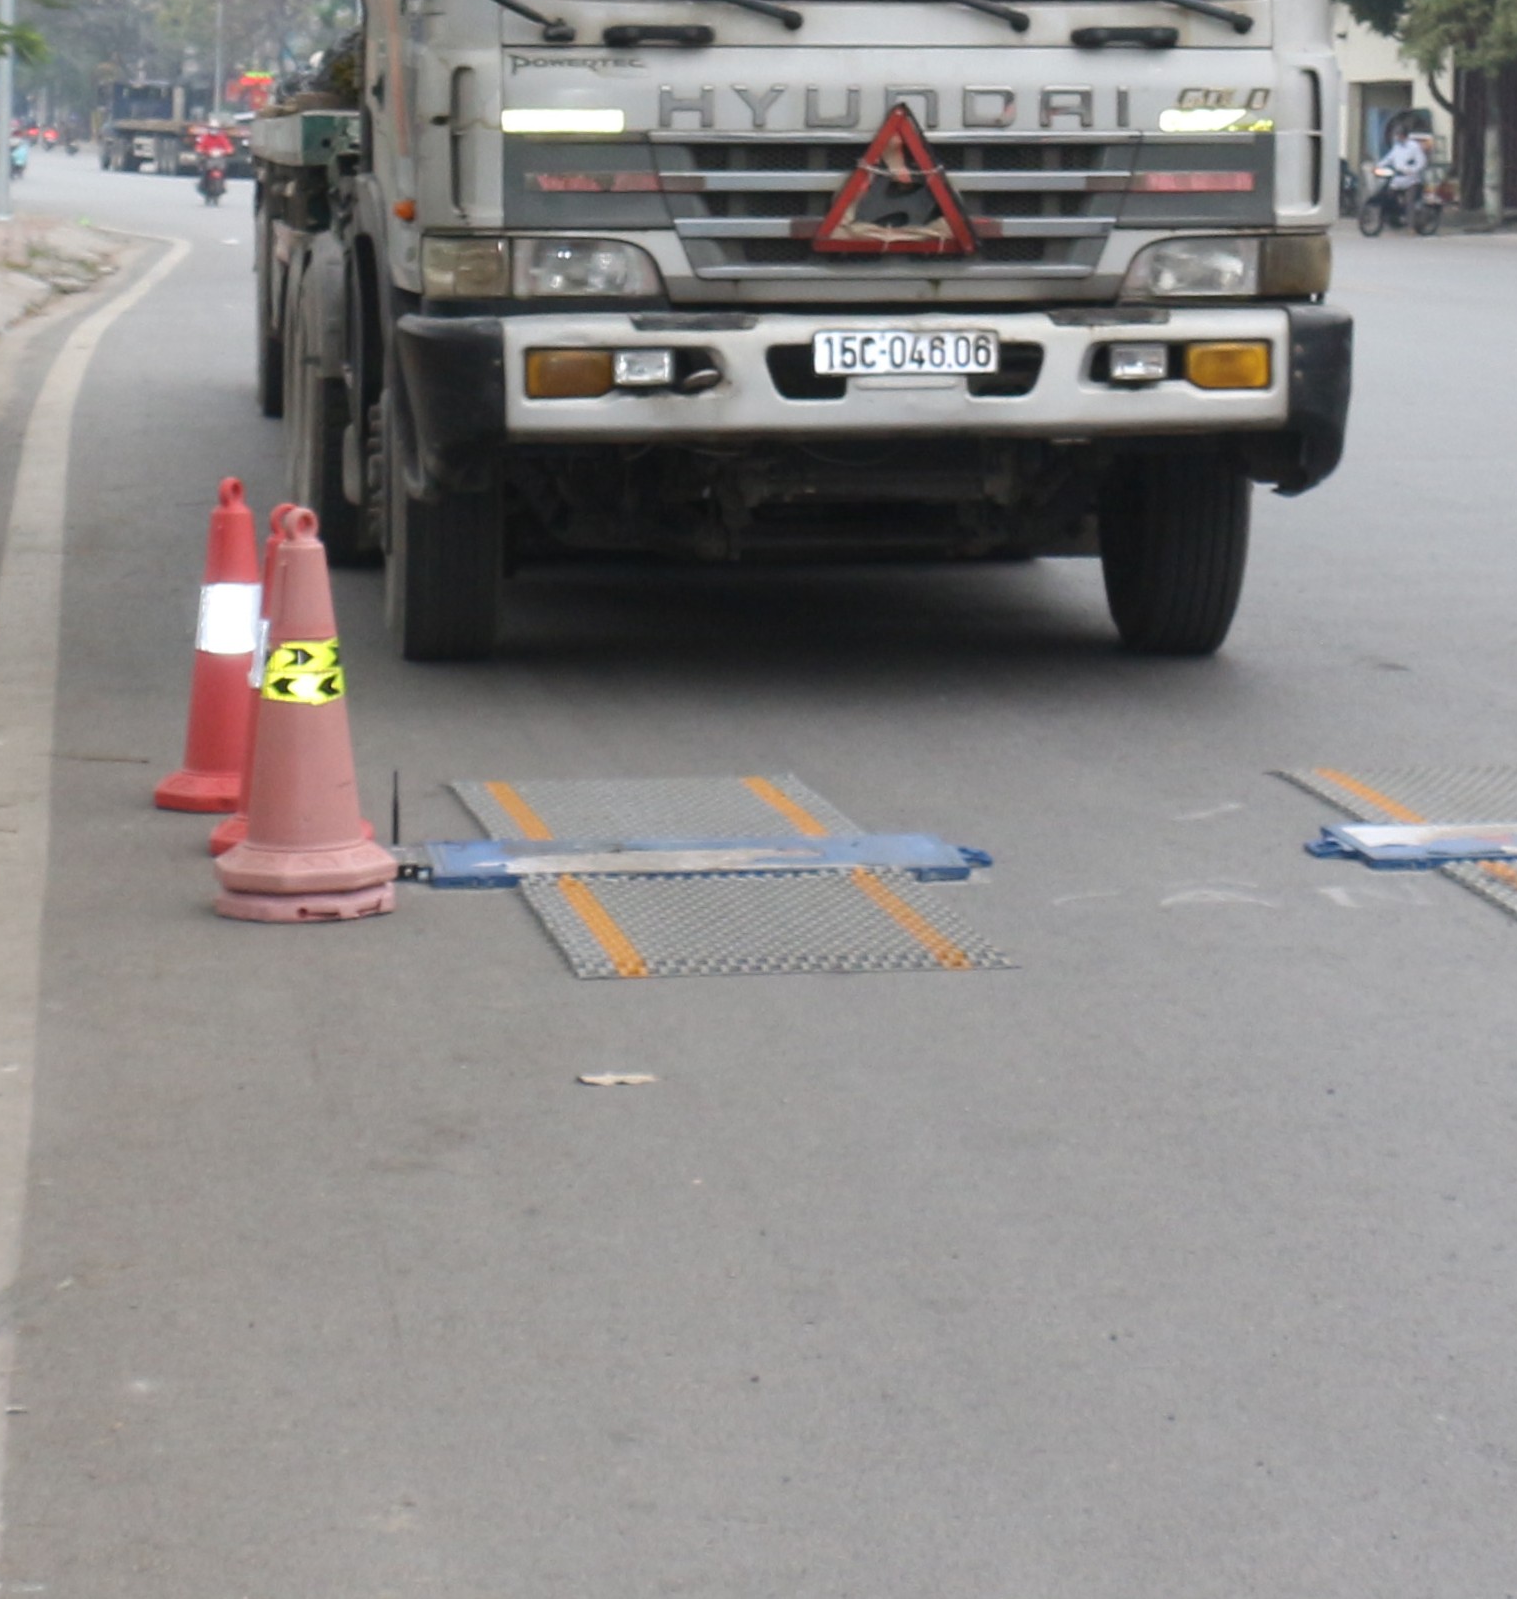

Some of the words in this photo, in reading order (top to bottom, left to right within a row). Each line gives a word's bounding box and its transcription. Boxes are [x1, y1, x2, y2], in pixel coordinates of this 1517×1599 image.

[657, 83, 1130, 129] HYUNDAI
[1176, 87, 1271, 110] GOD
[823, 334, 992, 370] 15C-046.06
